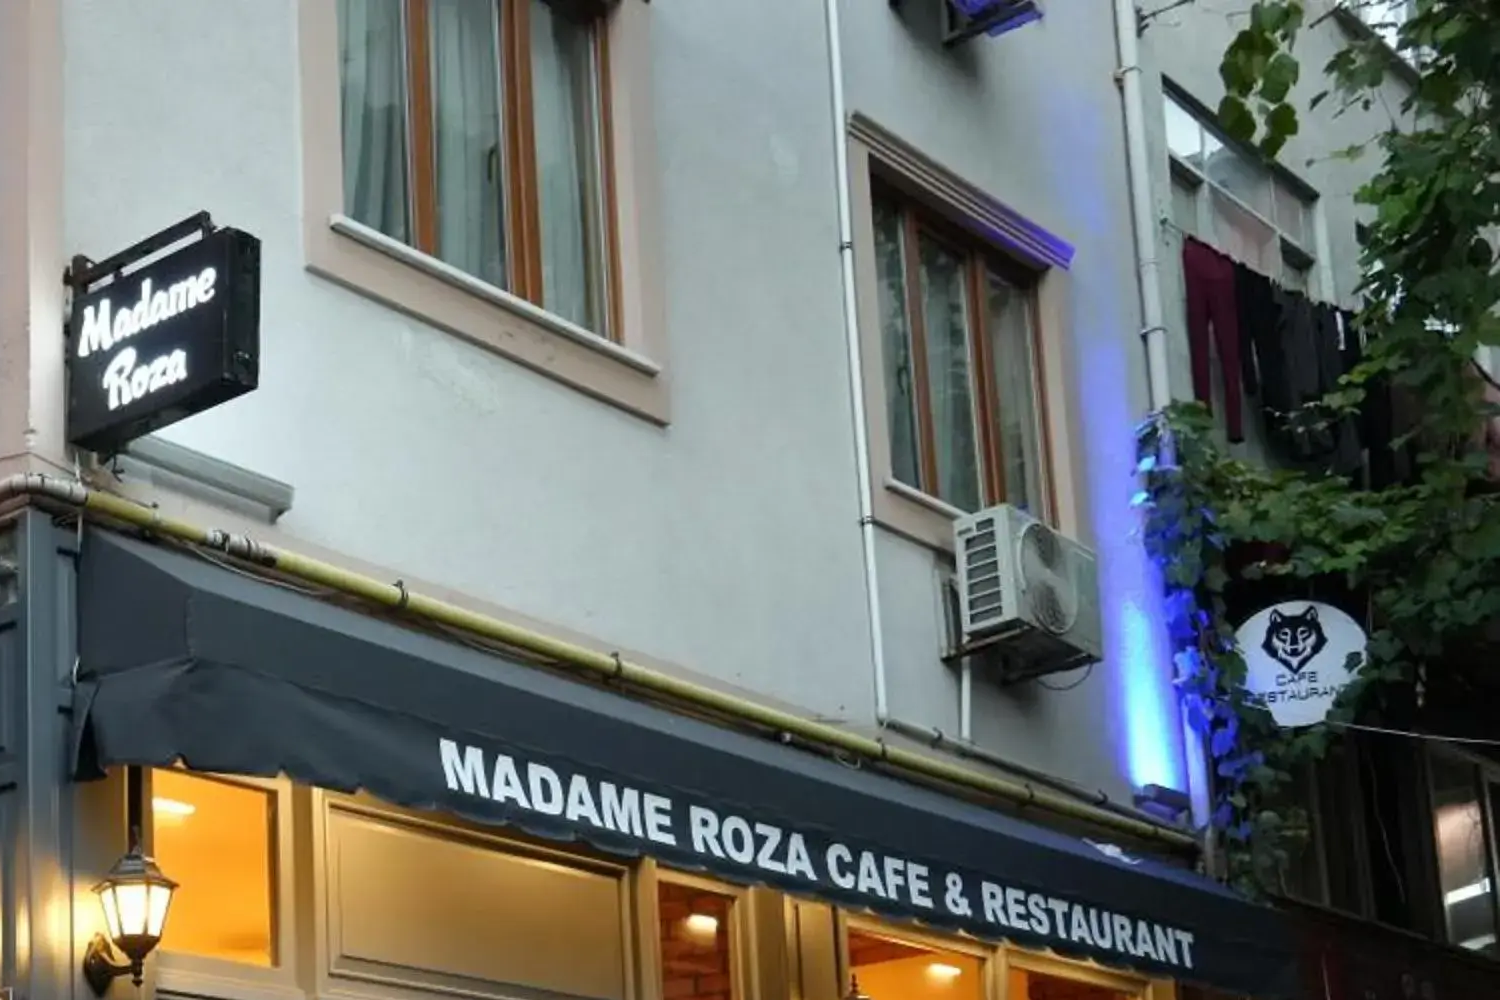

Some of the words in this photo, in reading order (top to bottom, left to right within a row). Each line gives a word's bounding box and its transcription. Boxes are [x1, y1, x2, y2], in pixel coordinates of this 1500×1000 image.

[78, 267, 217, 358] Madame
[102, 347, 188, 411] Roza
[1275, 671, 1318, 686] CAFE
[439, 738, 677, 846] MADAME
[690, 805, 818, 881] ROZA
[826, 843, 934, 909] CAFE
[945, 873, 973, 917] &
[981, 881, 1194, 968] RESTAURANT
